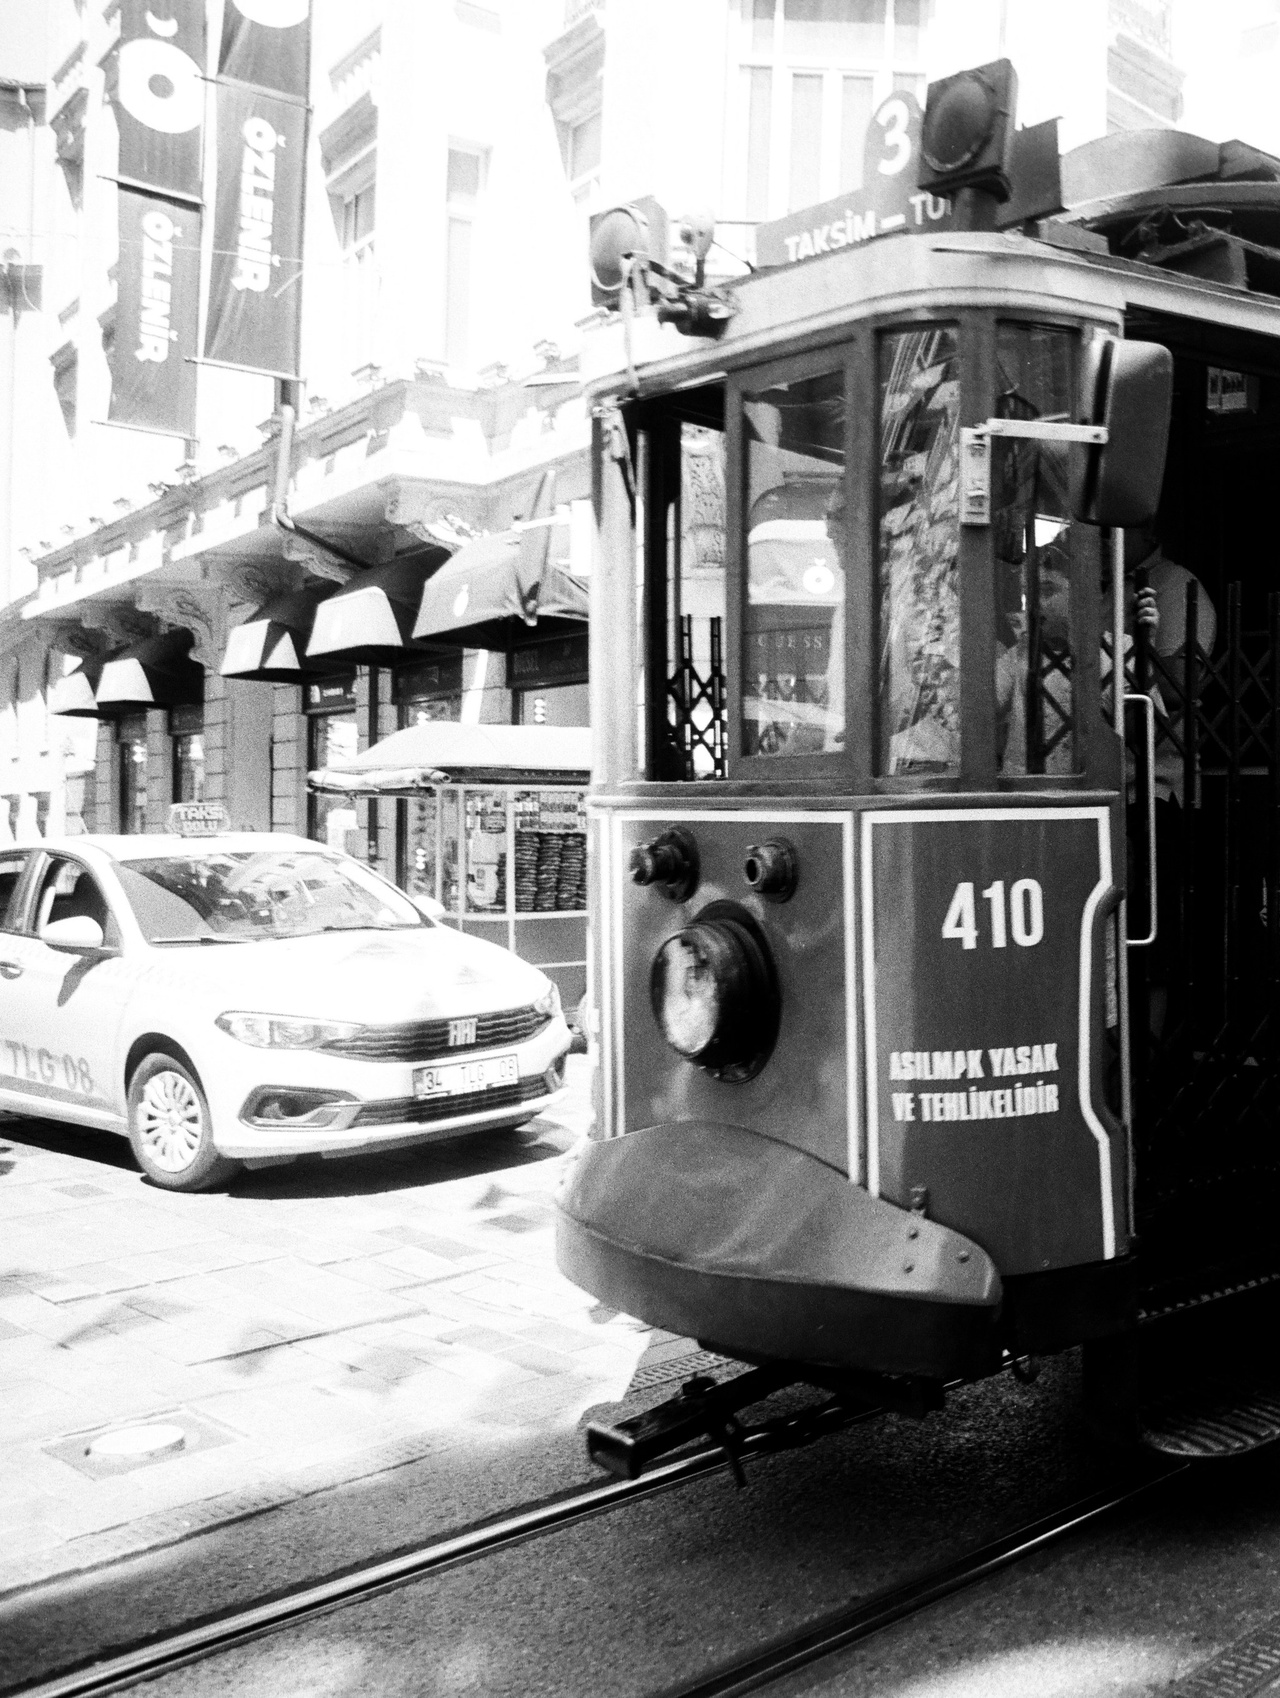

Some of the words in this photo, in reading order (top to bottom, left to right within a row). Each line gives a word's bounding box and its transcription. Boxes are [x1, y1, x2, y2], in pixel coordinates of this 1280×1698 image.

[876, 99, 912, 176] 3
[784, 209, 876, 262] TAKSİM
[942, 878, 1044, 950] 410
[5, 1039, 56, 1083] TLG
[62, 1053, 94, 1093] 08
[425, 1070, 442, 1090] 34
[988, 1042, 1060, 1077] YASAK
[891, 1092, 916, 1121] VE
[918, 1080, 1060, 1122] TEHLİKELİDİR
